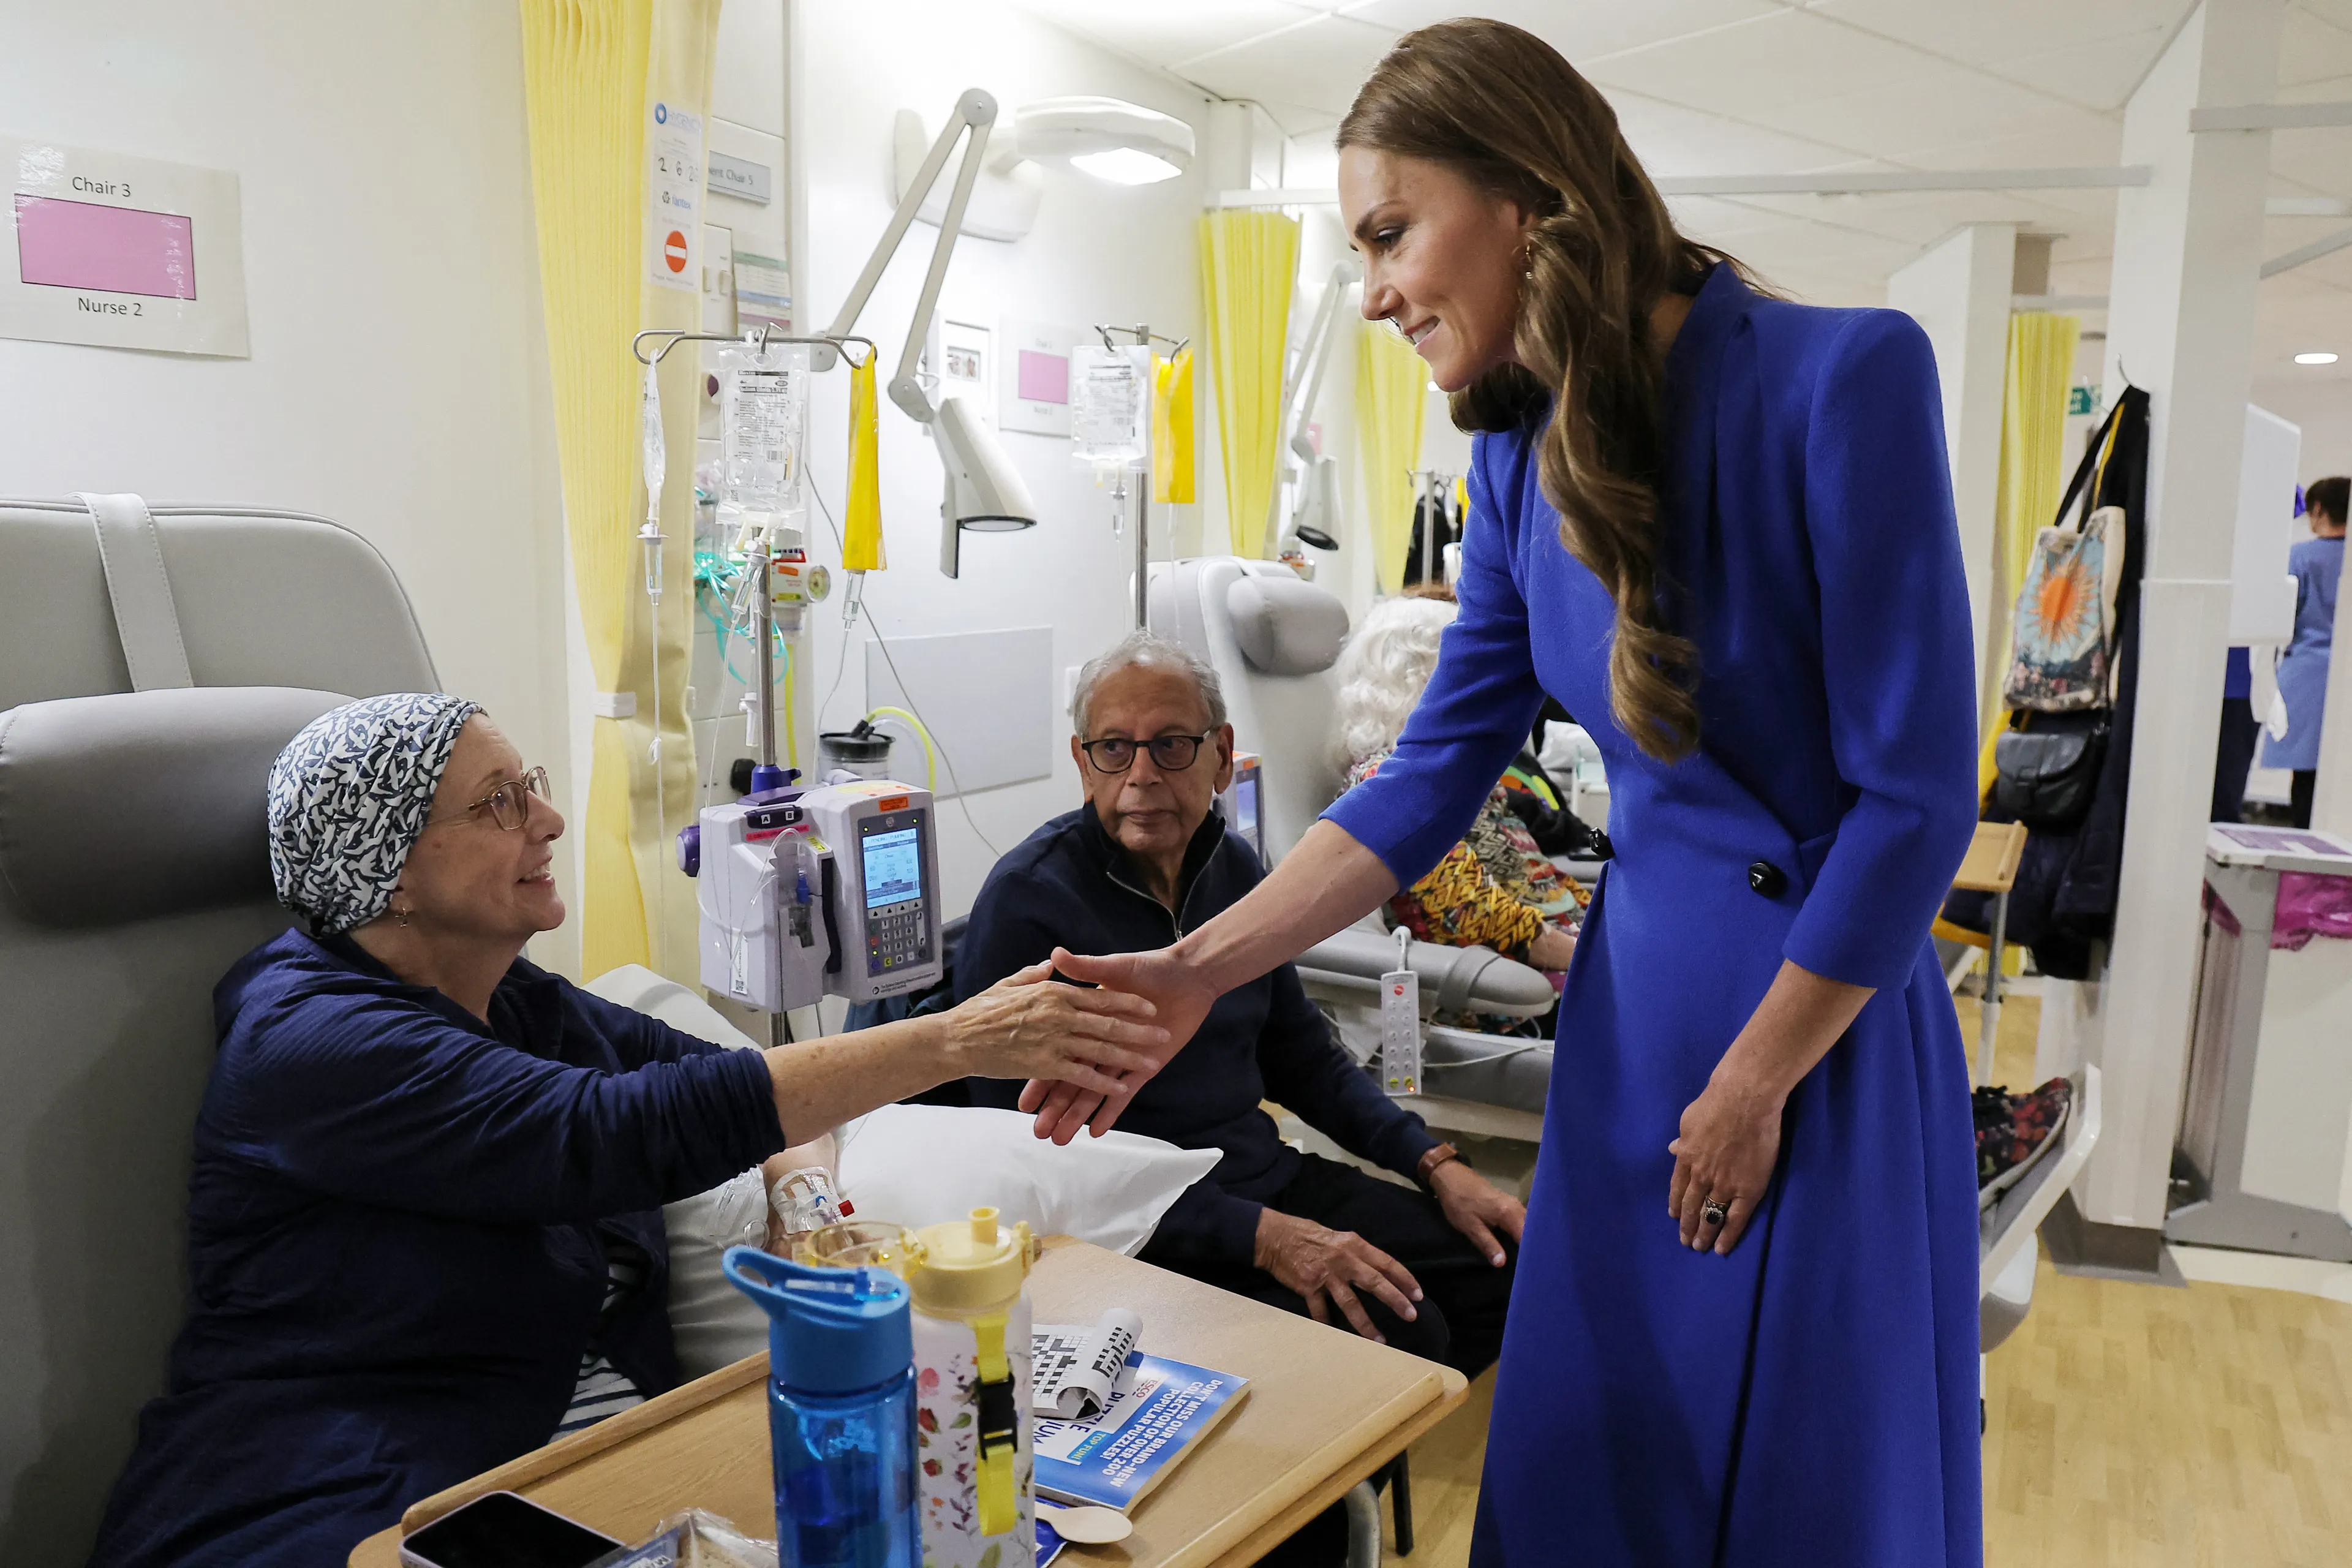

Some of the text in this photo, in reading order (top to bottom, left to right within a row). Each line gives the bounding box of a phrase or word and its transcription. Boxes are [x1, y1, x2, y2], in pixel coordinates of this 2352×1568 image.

[72, 176, 131, 197] Chair 3
[726, 169, 745, 183] Chair
[748, 175, 753, 184] 5
[78, 297, 143, 317] Nurse 2
[1136, 1378, 1159, 1398] ESCO
[1099, 1388, 1181, 1461] POPULAR PUZZLES!
[1102, 1381, 1204, 1476] COLLECTION OF OVER 200
[1109, 1379, 1224, 1488] DON'T MISS OUR BRAND-NEW
[1071, 1433, 1107, 1460] TOP FUN!
